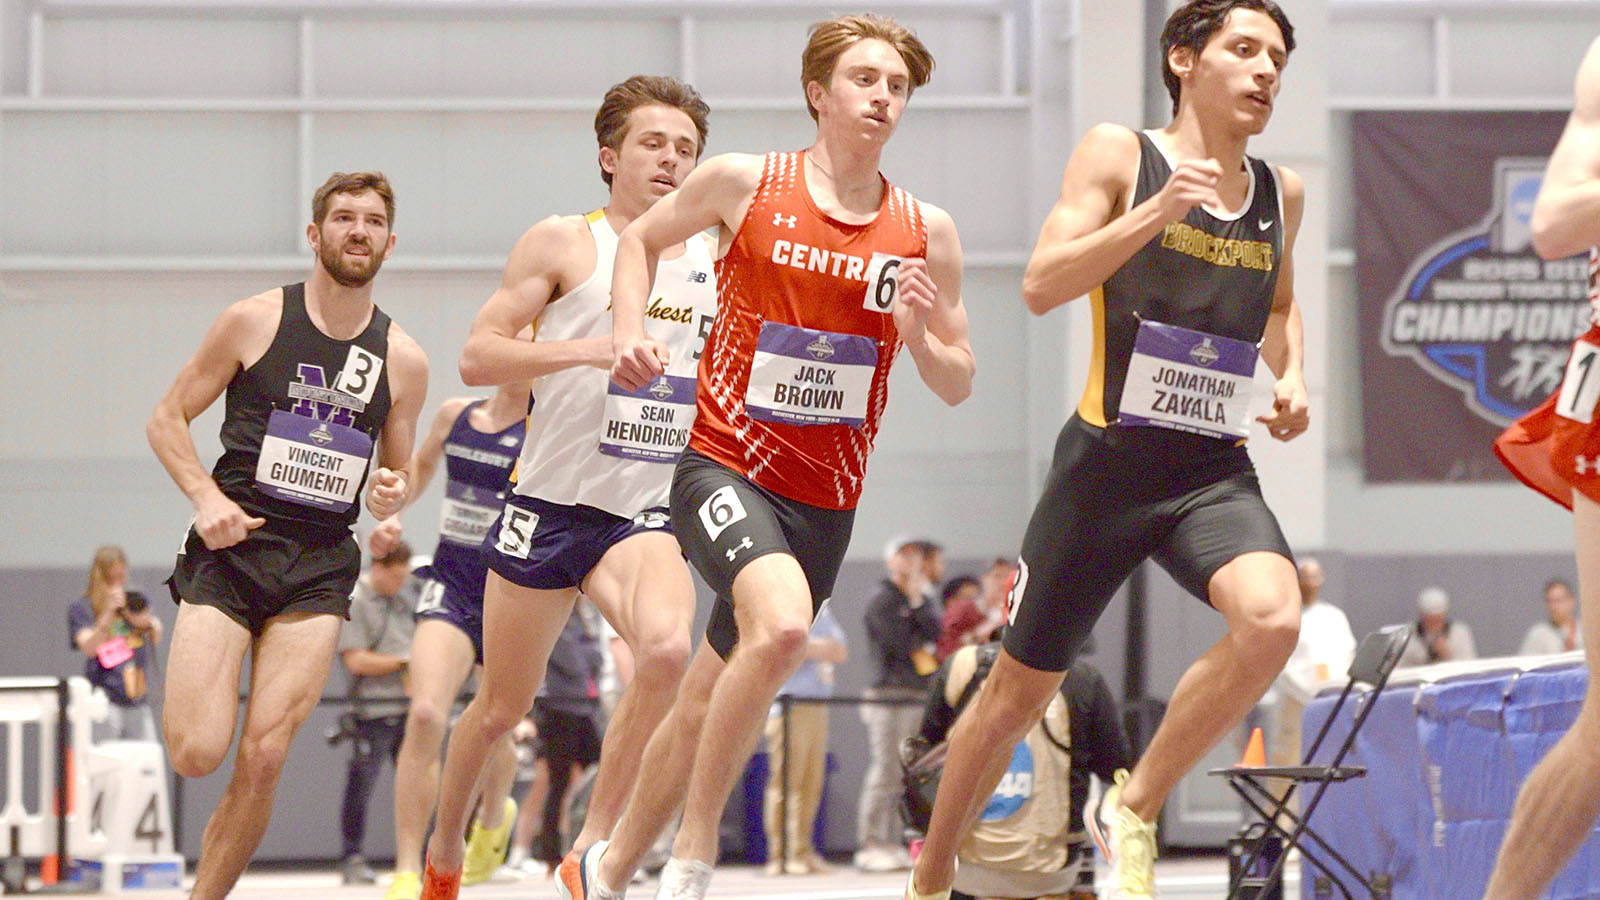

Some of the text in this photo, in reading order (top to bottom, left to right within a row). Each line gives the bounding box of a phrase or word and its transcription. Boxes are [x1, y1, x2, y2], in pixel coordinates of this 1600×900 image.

[1160, 221, 1273, 272] BROCKPORT
[875, 259, 901, 309] 6
[692, 314, 714, 360] 5
[346, 352, 373, 395] 3
[794, 366, 837, 386] JACK
[1152, 367, 1235, 398] JONATHAN
[773, 383, 844, 410] BROWN
[1151, 390, 1226, 425] ZAVALA
[640, 405, 675, 423] SEAN
[606, 420, 688, 447] HENDRICKS
[289, 446, 344, 472] VINCENT
[270, 462, 349, 496] GIUMENTI
[708, 493, 734, 527] 6
[504, 510, 530, 552] 5
[135, 792, 163, 854] 4
